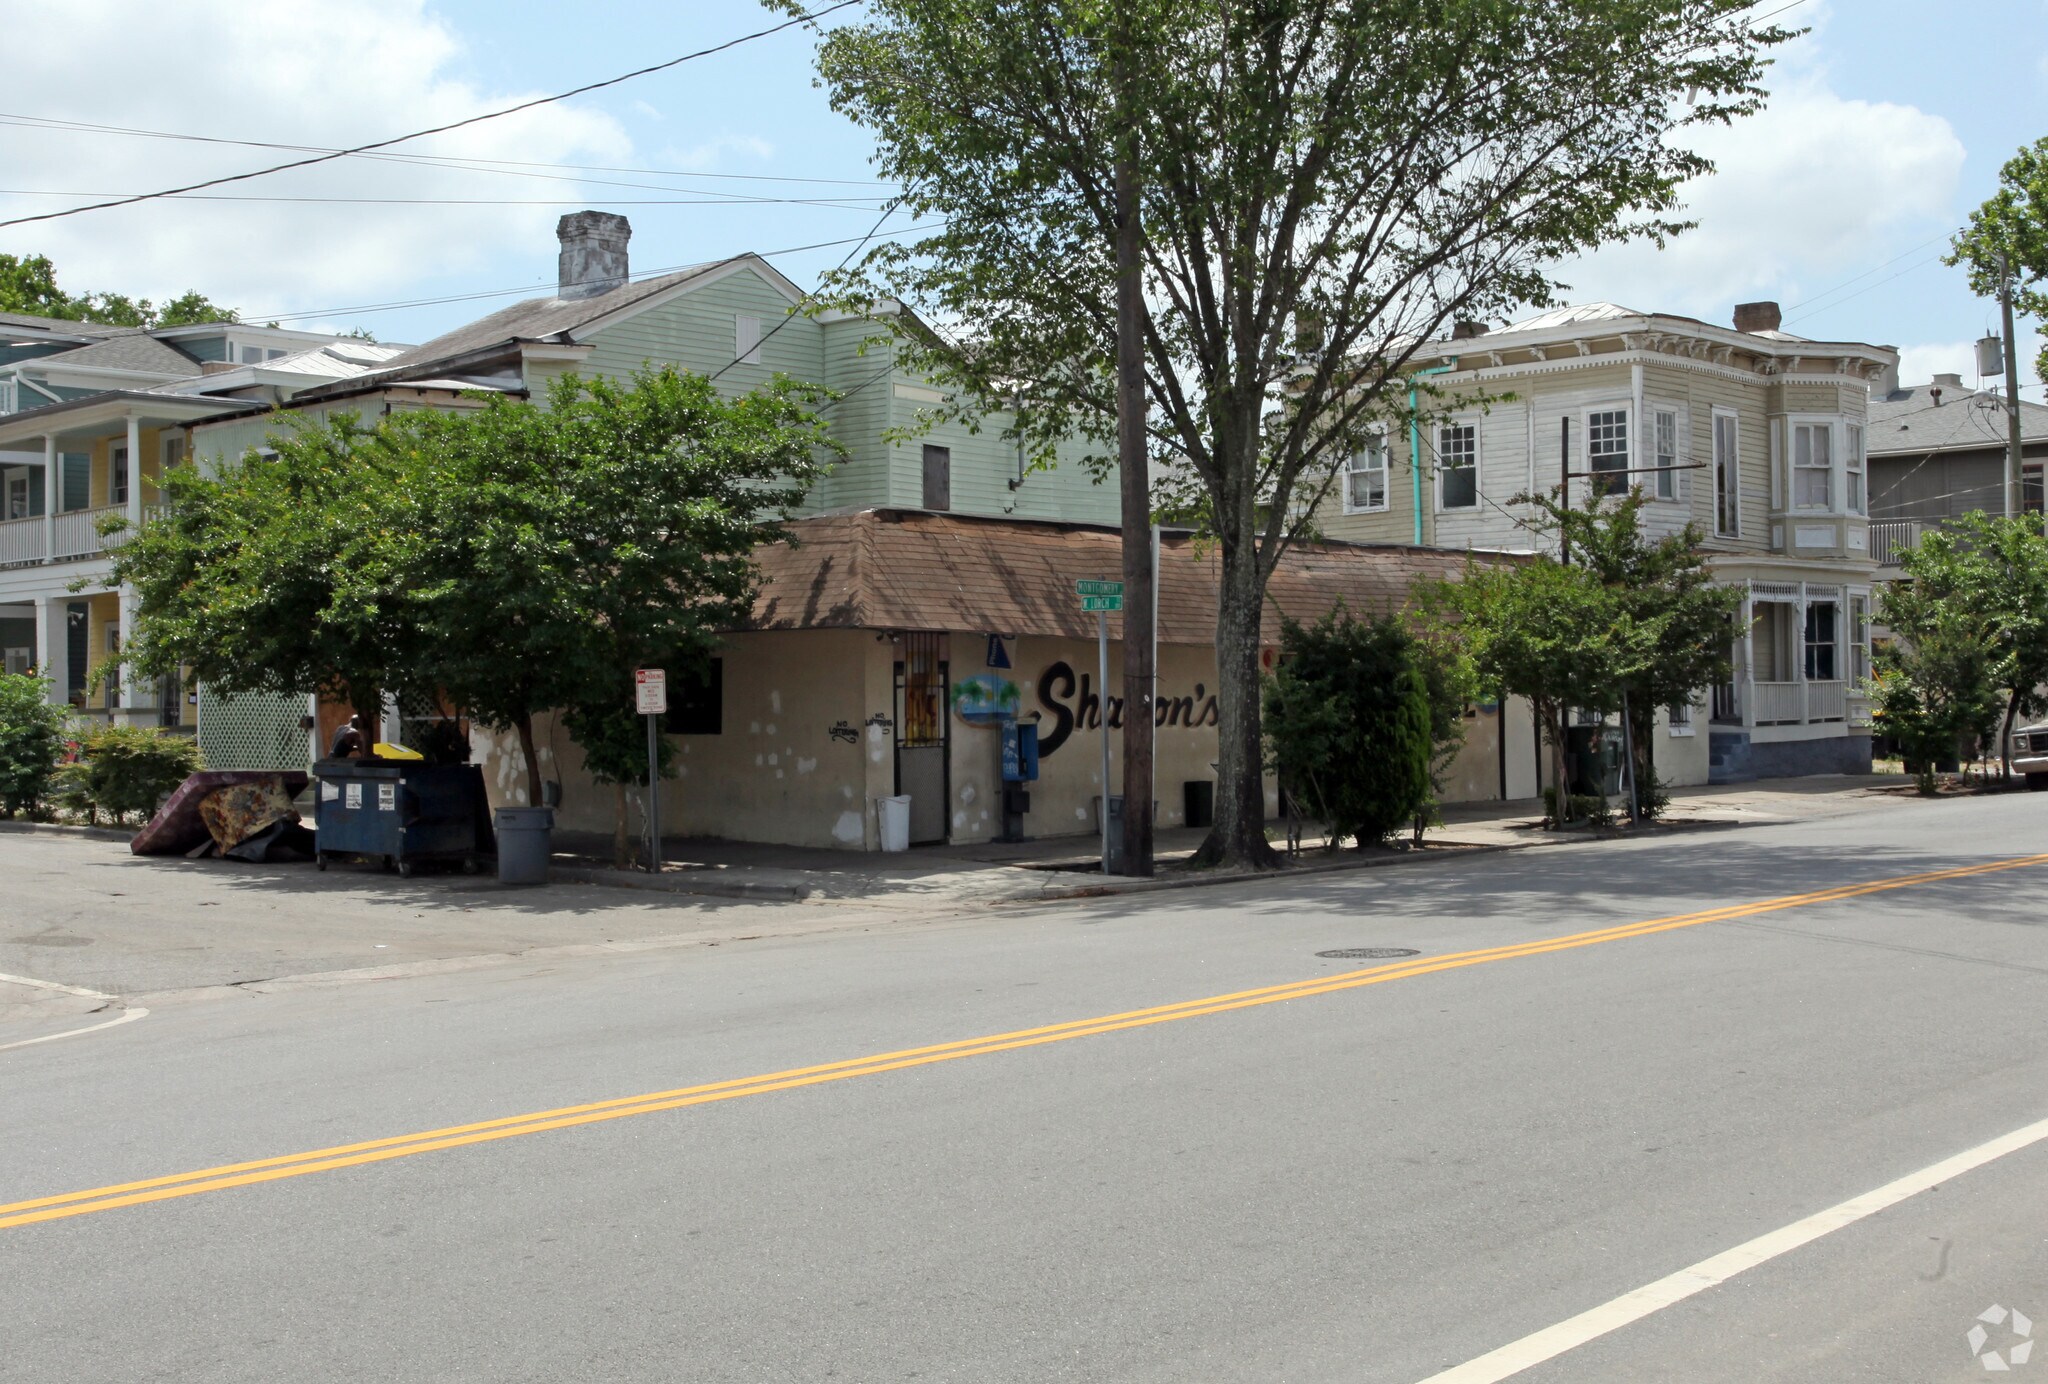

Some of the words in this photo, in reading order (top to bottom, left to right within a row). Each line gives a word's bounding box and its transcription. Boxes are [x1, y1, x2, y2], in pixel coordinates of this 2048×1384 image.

[1078, 581, 1119, 594] MONTGOMERY
[645, 673, 664, 681] PARKING
[1028, 661, 1219, 759] Shaon's
